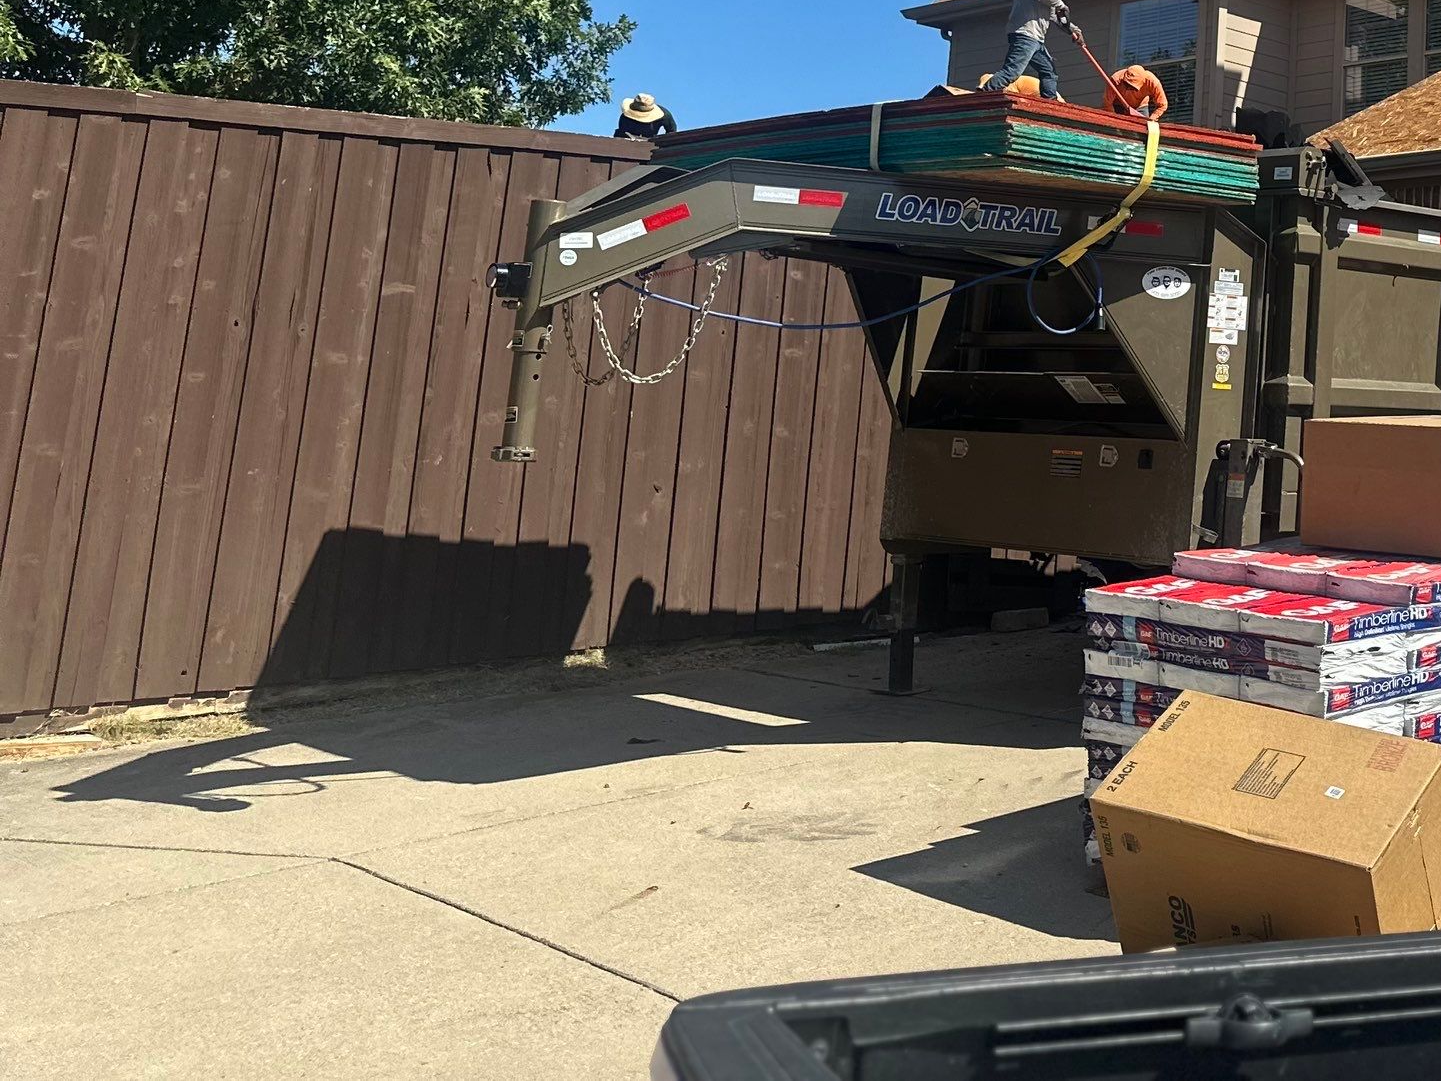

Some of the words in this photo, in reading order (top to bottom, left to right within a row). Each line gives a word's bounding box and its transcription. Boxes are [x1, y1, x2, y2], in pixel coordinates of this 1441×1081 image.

[876, 193, 964, 226] LOAD
[978, 202, 1062, 236] TRAIL
[1125, 578, 1199, 595] GAF
[1203, 589, 1275, 606] GAF
[1281, 600, 1358, 617] GAF
[1353, 609, 1409, 630] Timberline
[1155, 627, 1208, 649] Timberline
[1353, 676, 1411, 698] Timberline
[1158, 713, 1182, 733] MODEL
[1176, 700, 1191, 713] 135
[1113, 761, 1139, 785] EACH
[1102, 831, 1115, 857] MODEL
